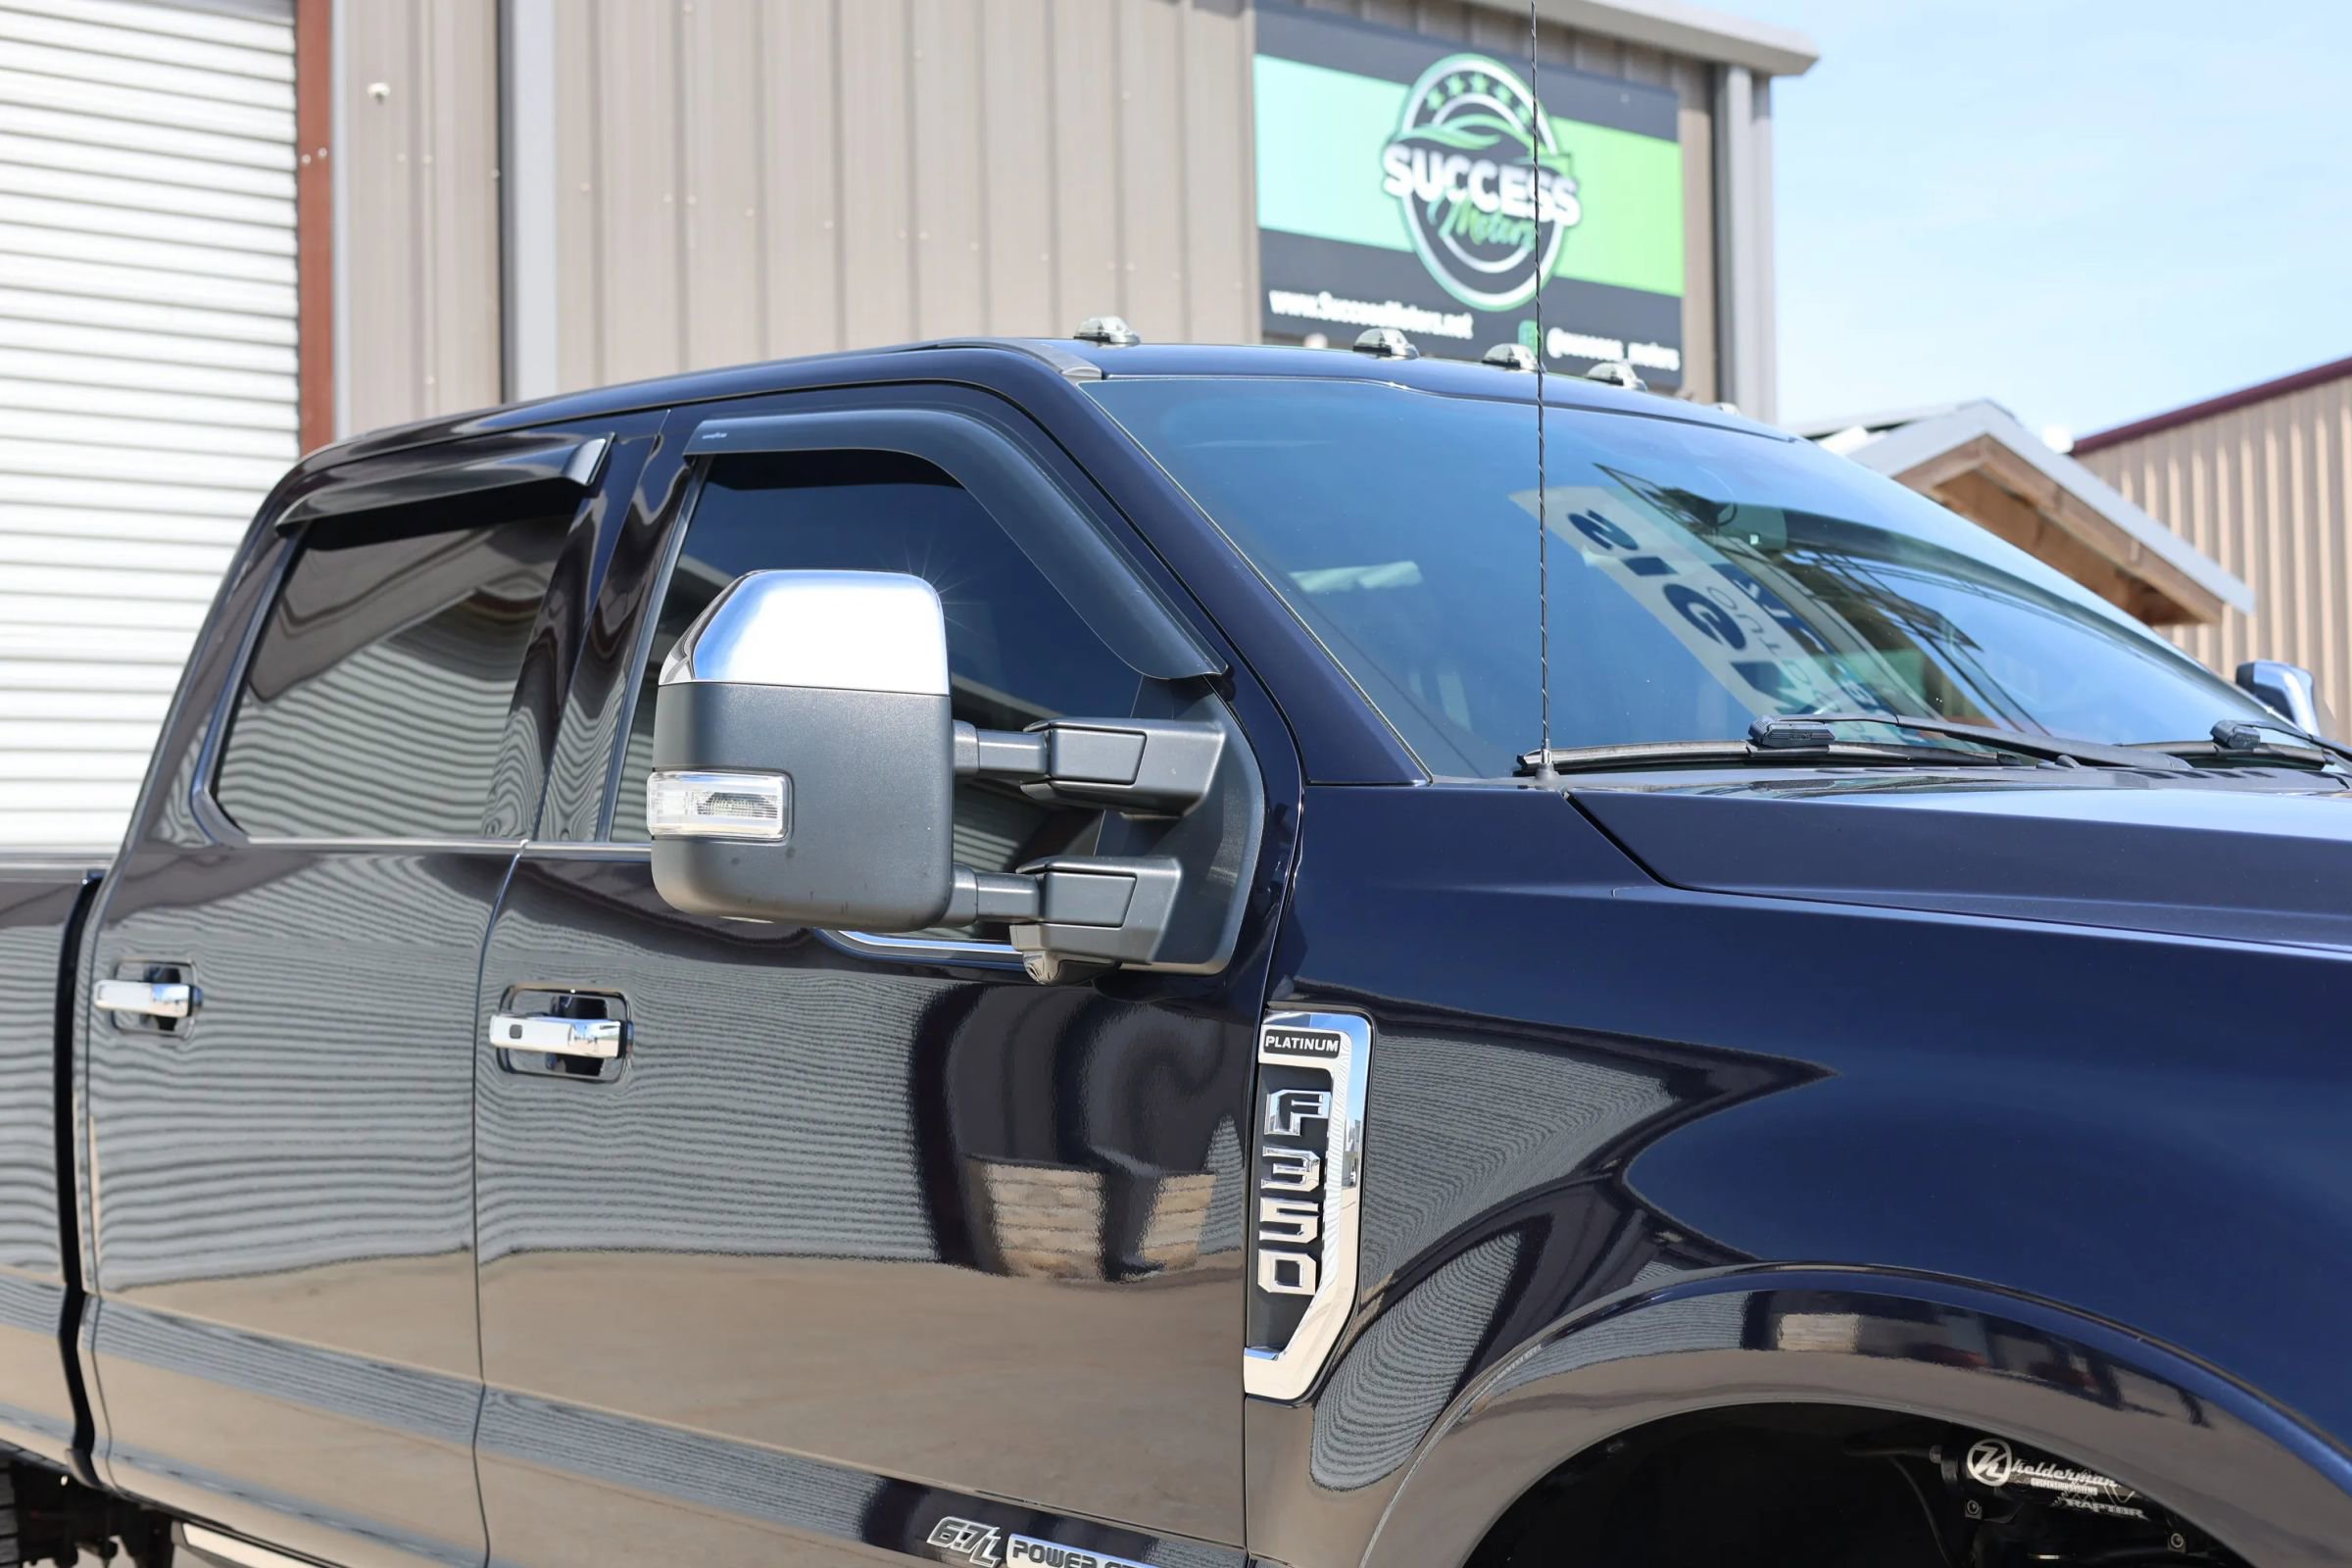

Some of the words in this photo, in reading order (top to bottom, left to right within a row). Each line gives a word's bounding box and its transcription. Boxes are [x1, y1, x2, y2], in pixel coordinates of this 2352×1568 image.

[1383, 144, 1581, 226] SUCCESS
[1264, 1035, 1340, 1053] PLATINUM
[1257, 1089, 1333, 1296] F350
[2065, 1498, 2148, 1520] RAPTOR
[926, 1516, 1001, 1568] 6.7L
[1012, 1540, 1099, 1568] POWER
